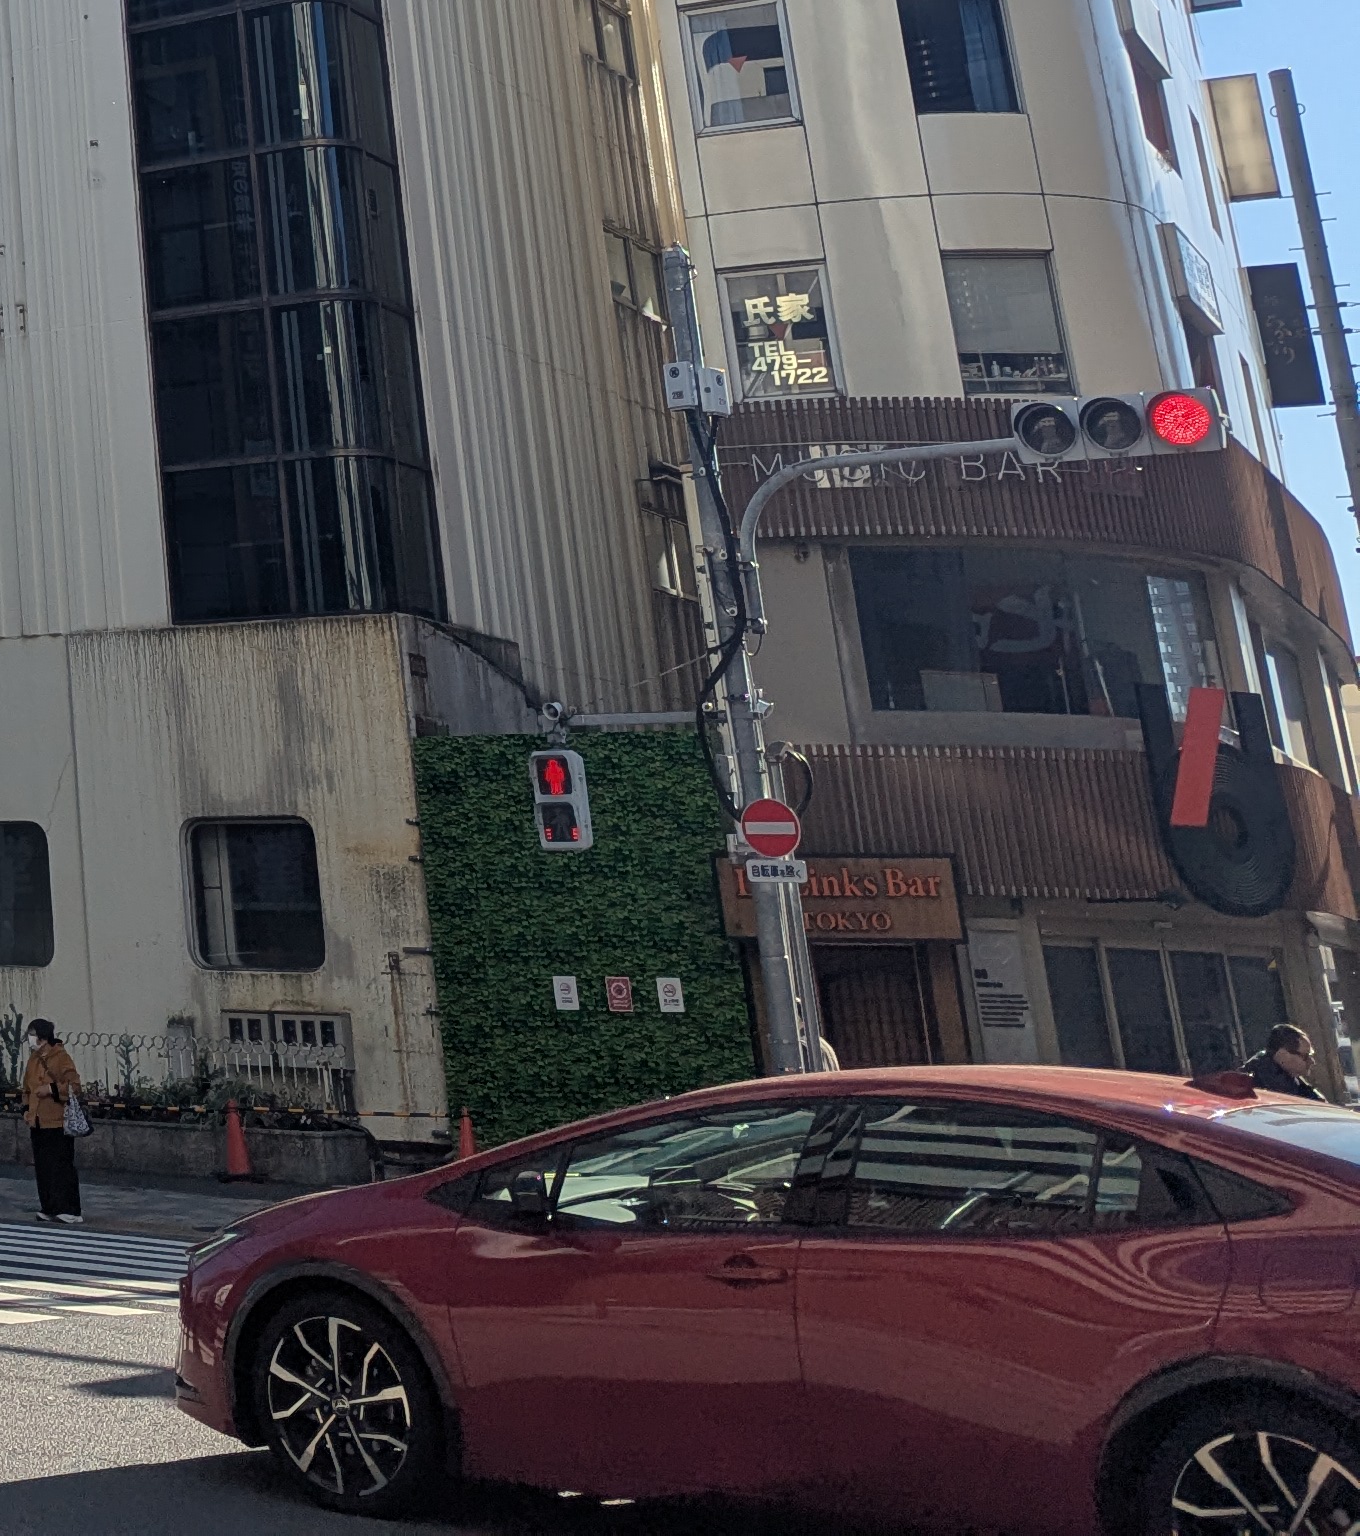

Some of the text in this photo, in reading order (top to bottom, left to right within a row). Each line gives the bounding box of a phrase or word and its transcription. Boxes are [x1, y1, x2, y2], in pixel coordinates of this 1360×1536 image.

[743, 293, 814, 326] 氏家
[748, 340, 794, 358] TEL
[771, 367, 828, 385] 1722
[883, 867, 941, 898] Bar
[803, 912, 892, 931] TOKYO
